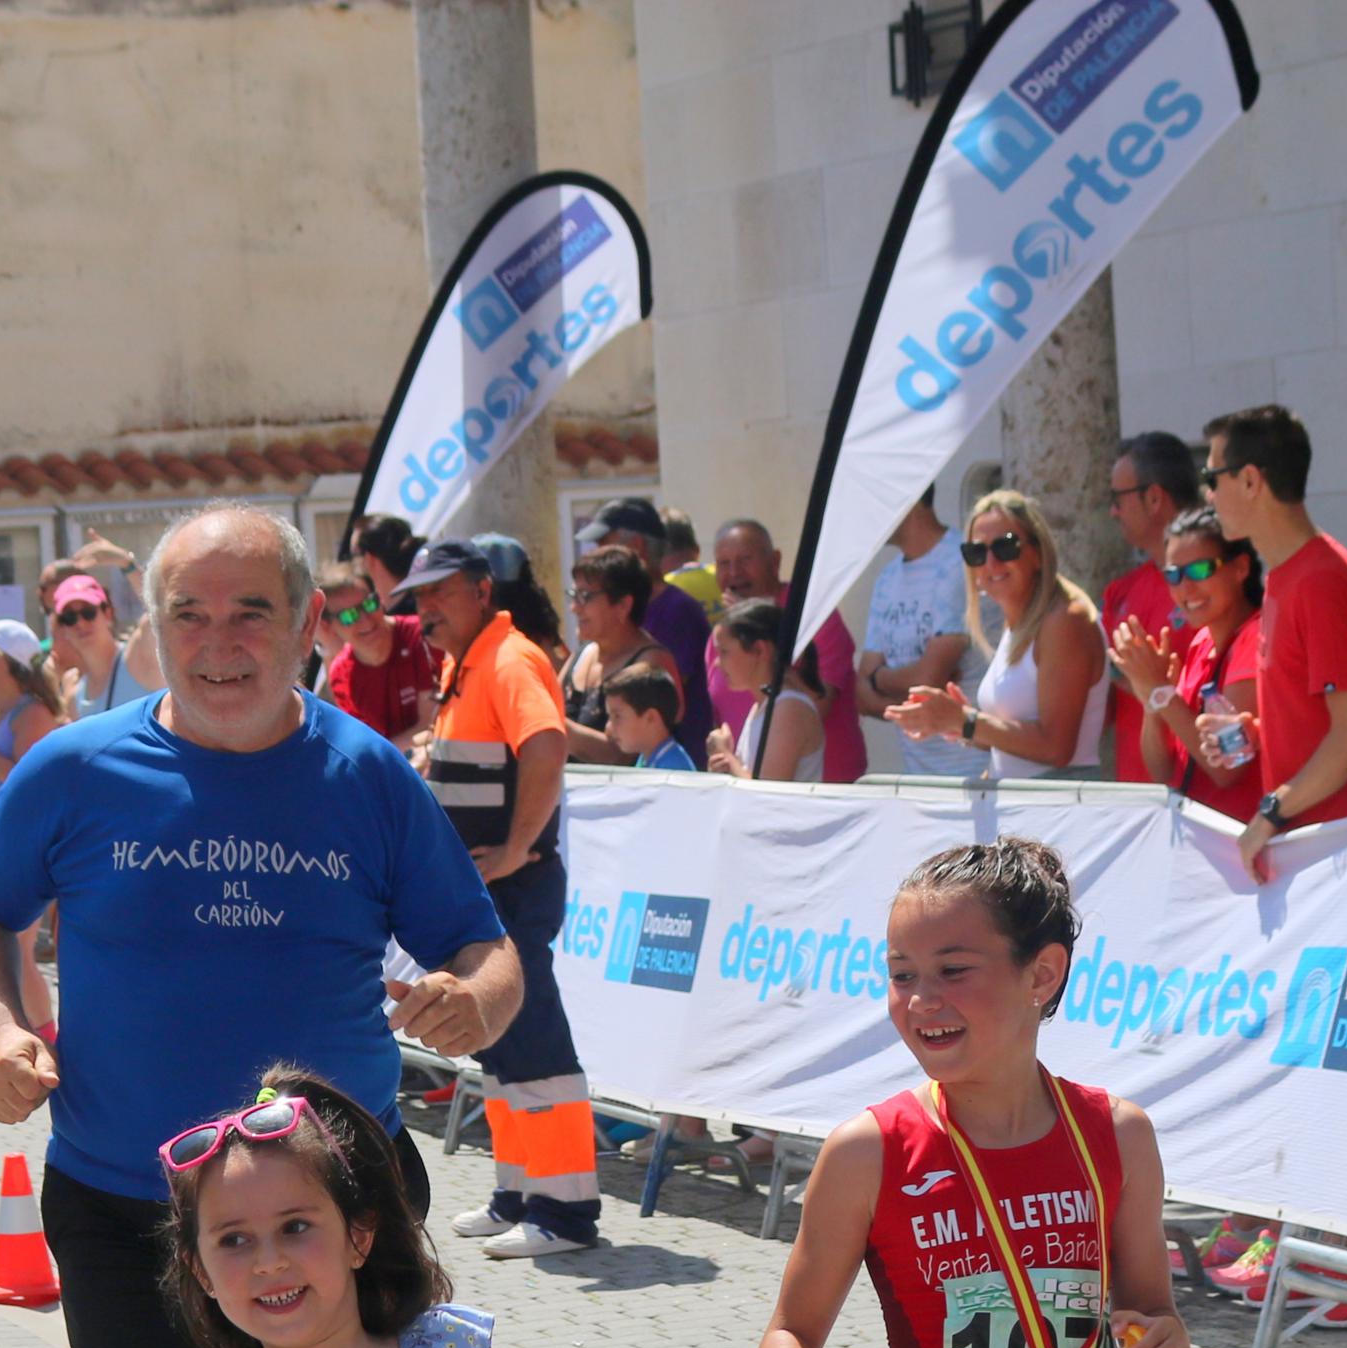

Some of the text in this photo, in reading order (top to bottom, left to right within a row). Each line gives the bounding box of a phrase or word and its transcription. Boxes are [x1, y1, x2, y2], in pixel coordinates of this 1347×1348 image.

[1021, 2, 1125, 102] Diputación
[896, 79, 1204, 412] deportes
[399, 283, 618, 513] deportes
[223, 880, 252, 900] DEL
[1065, 936, 1277, 1047] deportes
[911, 1209, 968, 1249] E.M.
[916, 1248, 992, 1285] Venta
